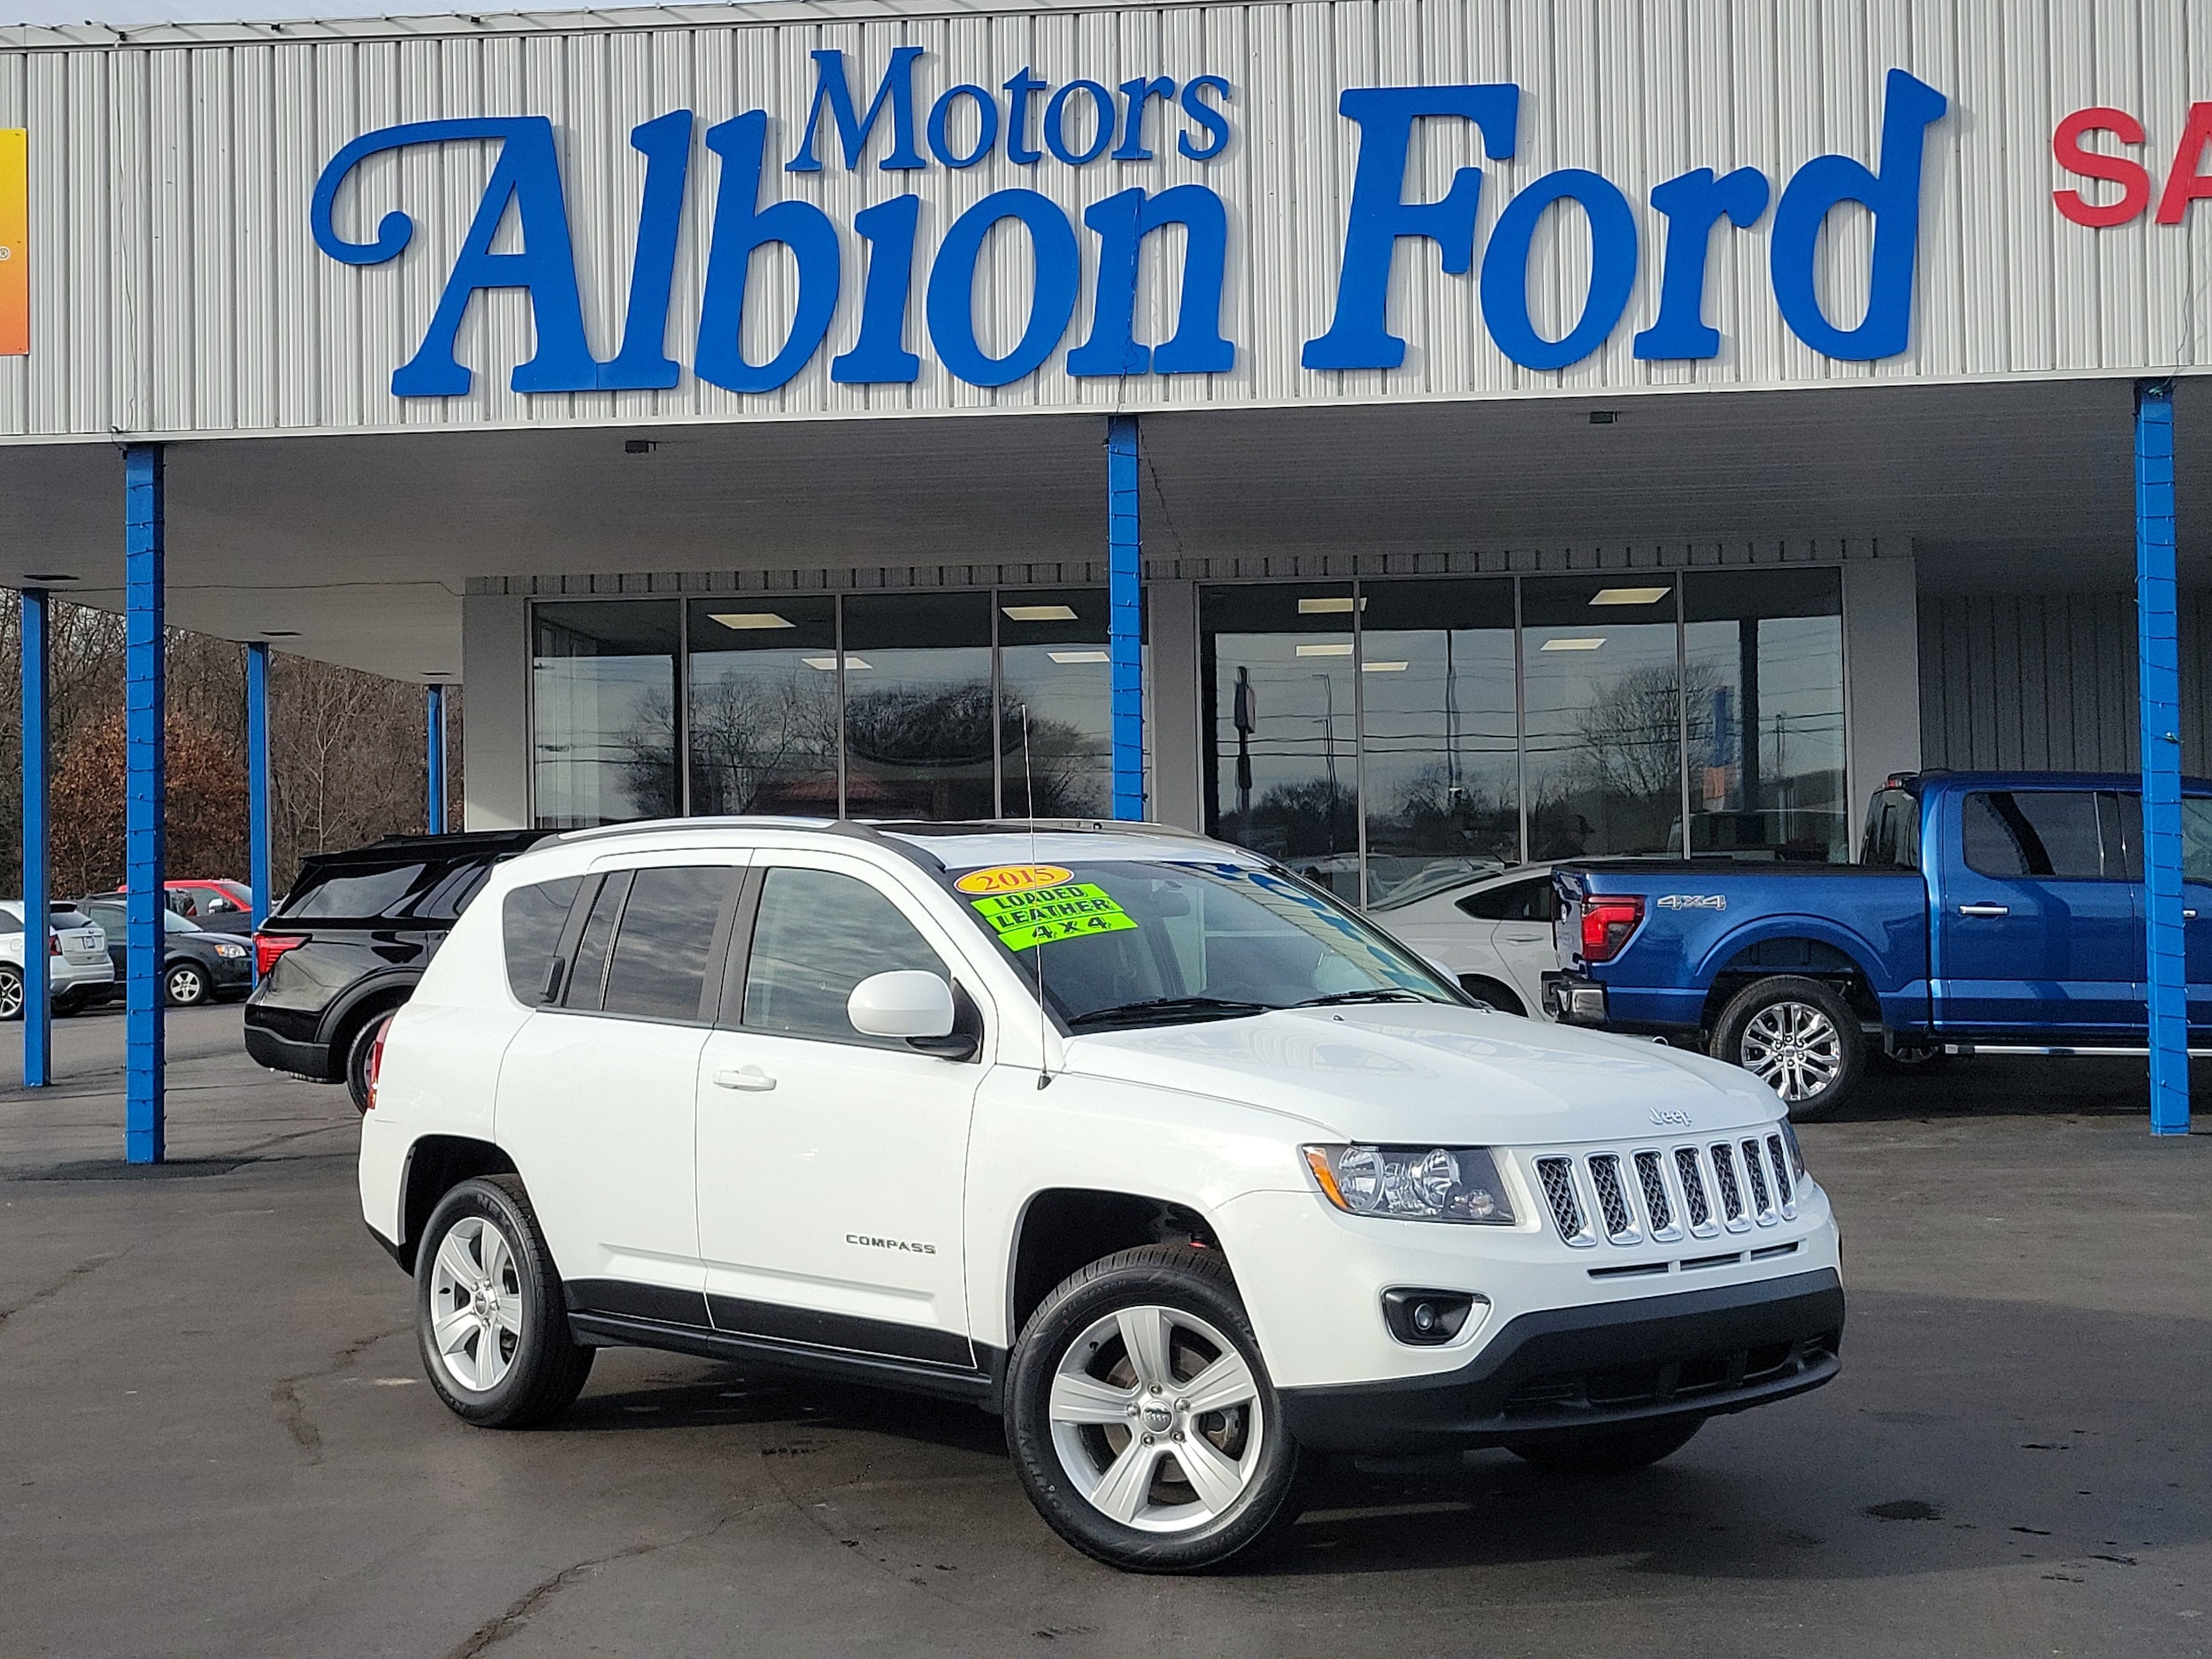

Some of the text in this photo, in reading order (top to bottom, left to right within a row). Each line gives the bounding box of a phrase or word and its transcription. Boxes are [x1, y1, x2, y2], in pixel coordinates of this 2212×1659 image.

[786, 47, 1228, 172] Motors
[311, 69, 1947, 397] Albion Ford
[975, 867, 1056, 891] 2015
[994, 887, 1087, 910] LOADED
[996, 898, 1111, 928] LEATHER
[1648, 1106, 1693, 1127] Jeep
[845, 1233, 937, 1255] COMPASS
